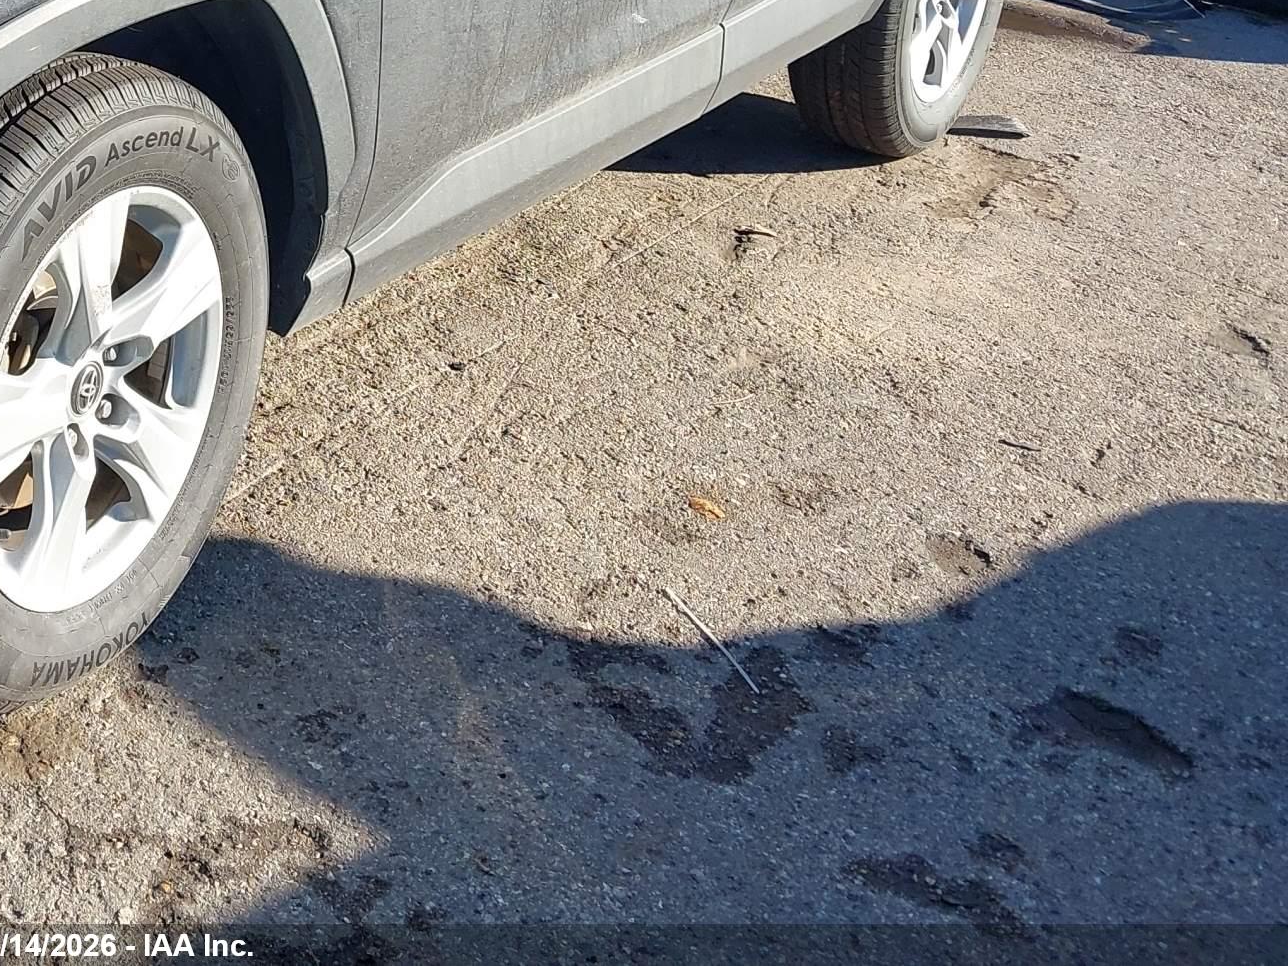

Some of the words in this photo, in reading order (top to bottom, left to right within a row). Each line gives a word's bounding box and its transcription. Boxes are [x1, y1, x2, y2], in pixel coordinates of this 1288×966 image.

[21, 155, 97, 260] AVID
[104, 126, 186, 168] Ascend
[185, 126, 221, 163] LX
[31, 612, 150, 687] YOKOHAMA
